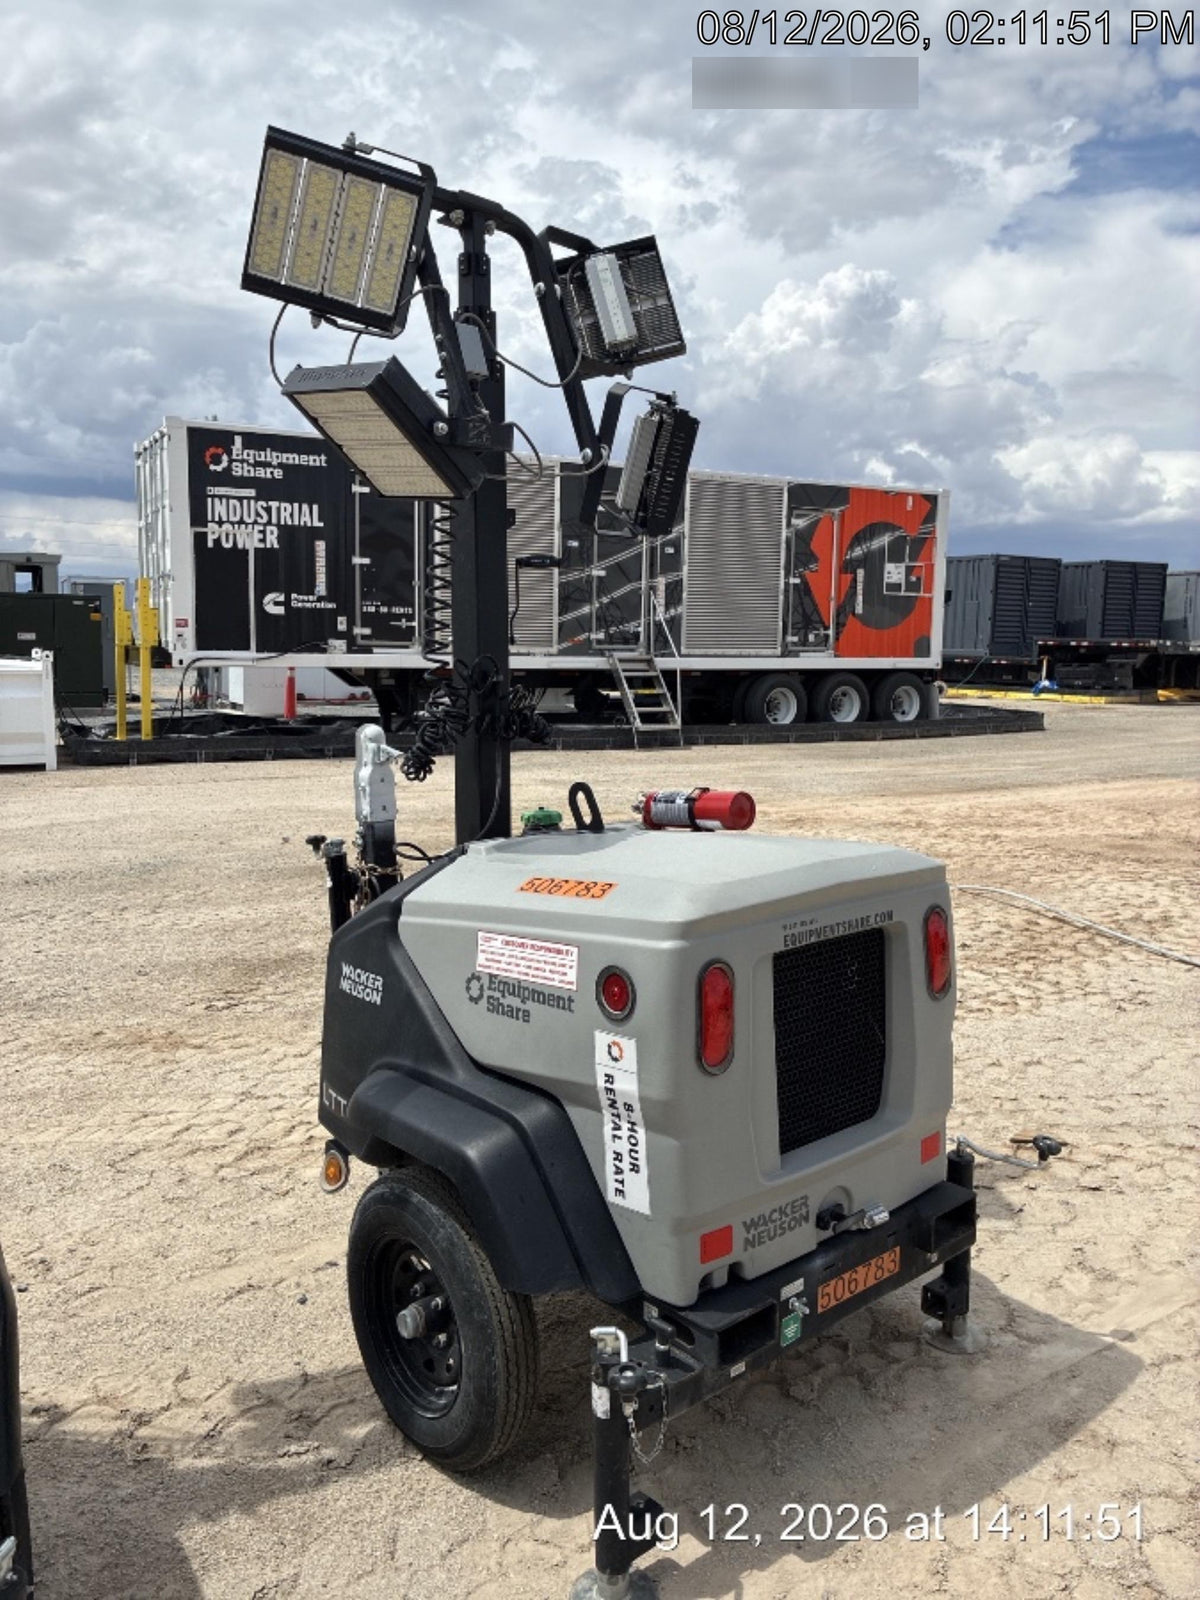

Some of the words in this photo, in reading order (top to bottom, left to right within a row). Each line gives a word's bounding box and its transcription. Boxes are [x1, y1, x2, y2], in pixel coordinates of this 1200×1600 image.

[231, 446, 327, 467] Equipment
[231, 462, 283, 479] Share
[207, 497, 324, 527] INDUSTRIAL
[207, 522, 280, 549] POWER
[520, 877, 613, 899] 506783
[339, 976, 383, 1006] NEUSON
[341, 962, 383, 991] WACKER
[487, 973, 575, 1014] Equipment
[486, 995, 531, 1023] Share
[604, 1072, 623, 1144] RENTAL
[623, 1101, 641, 1175] 8-HOUR
[613, 1150, 627, 1200] RATE
[742, 1194, 810, 1235] WACKER
[743, 1210, 810, 1252] NEUSON
[819, 1249, 898, 1310] 506783
